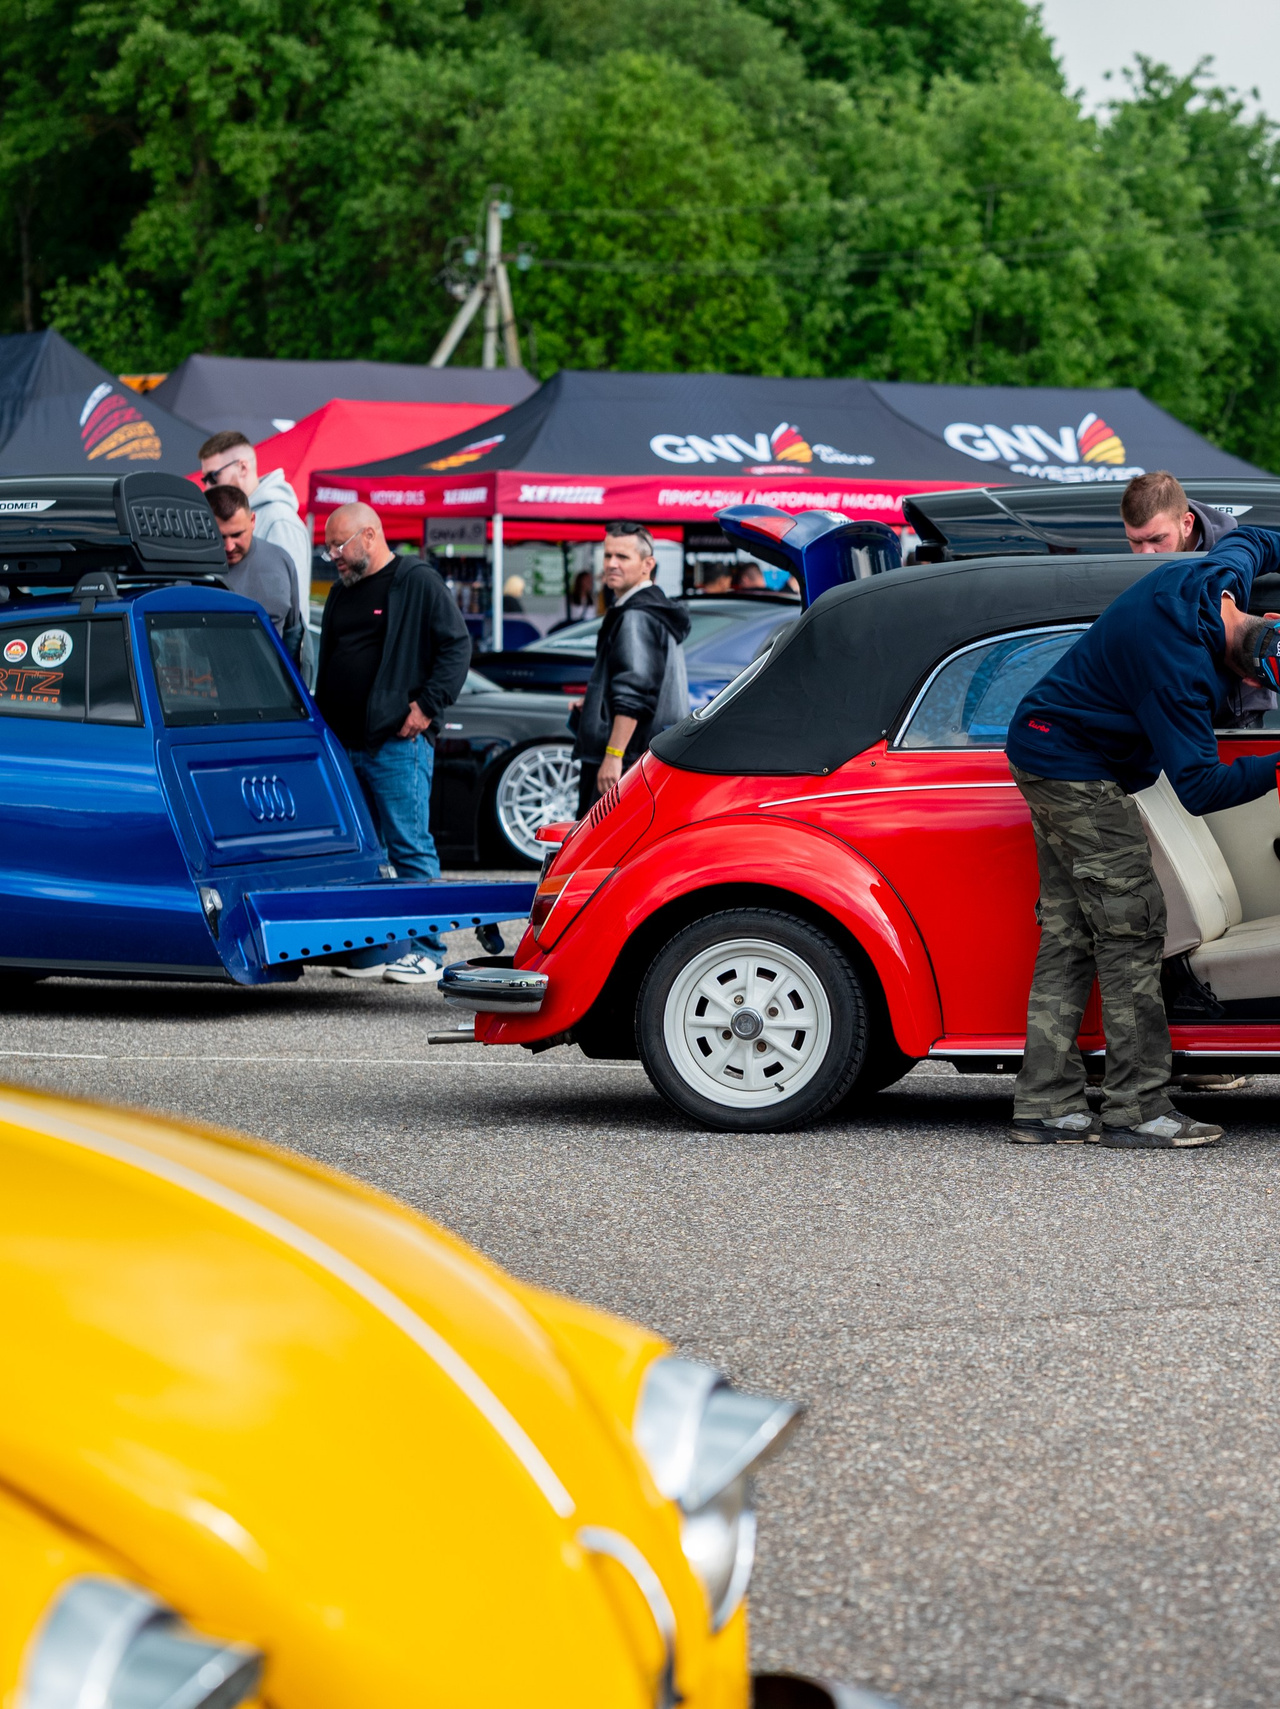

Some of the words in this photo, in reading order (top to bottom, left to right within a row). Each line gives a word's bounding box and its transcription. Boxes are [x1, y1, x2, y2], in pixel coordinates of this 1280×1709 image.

[650, 433, 772, 463] GNV
[943, 422, 1079, 463] GNV
[131, 506, 217, 540] BROOMER
